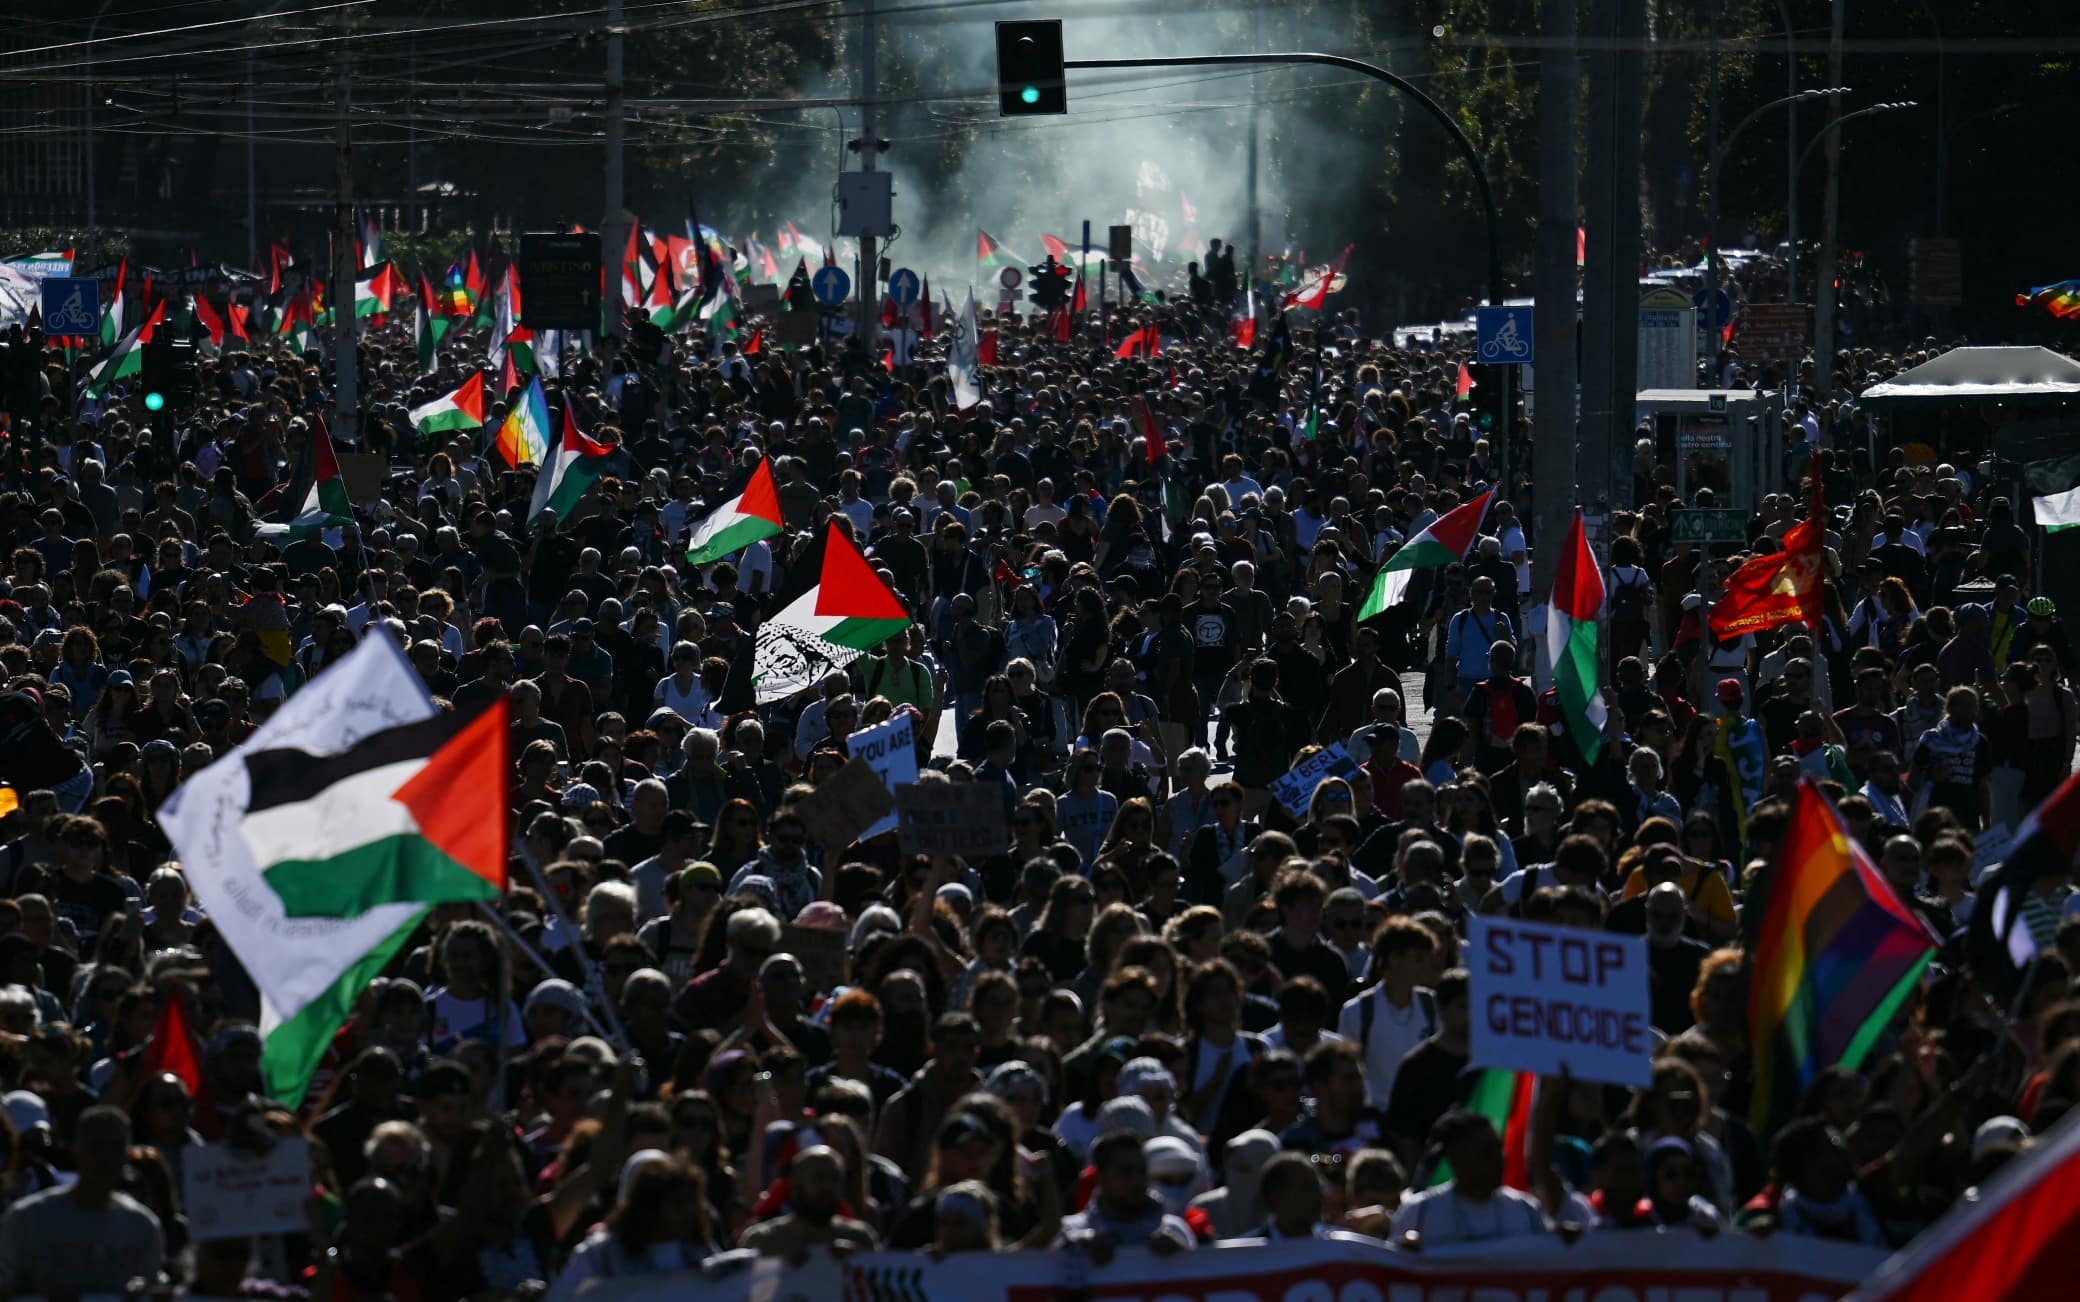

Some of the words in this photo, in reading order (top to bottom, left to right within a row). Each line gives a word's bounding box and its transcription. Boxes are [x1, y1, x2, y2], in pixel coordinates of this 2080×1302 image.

[889, 727, 911, 752] ARE
[1486, 926, 1624, 986] STOP
[1487, 994, 1644, 1054] GENOCIDE
